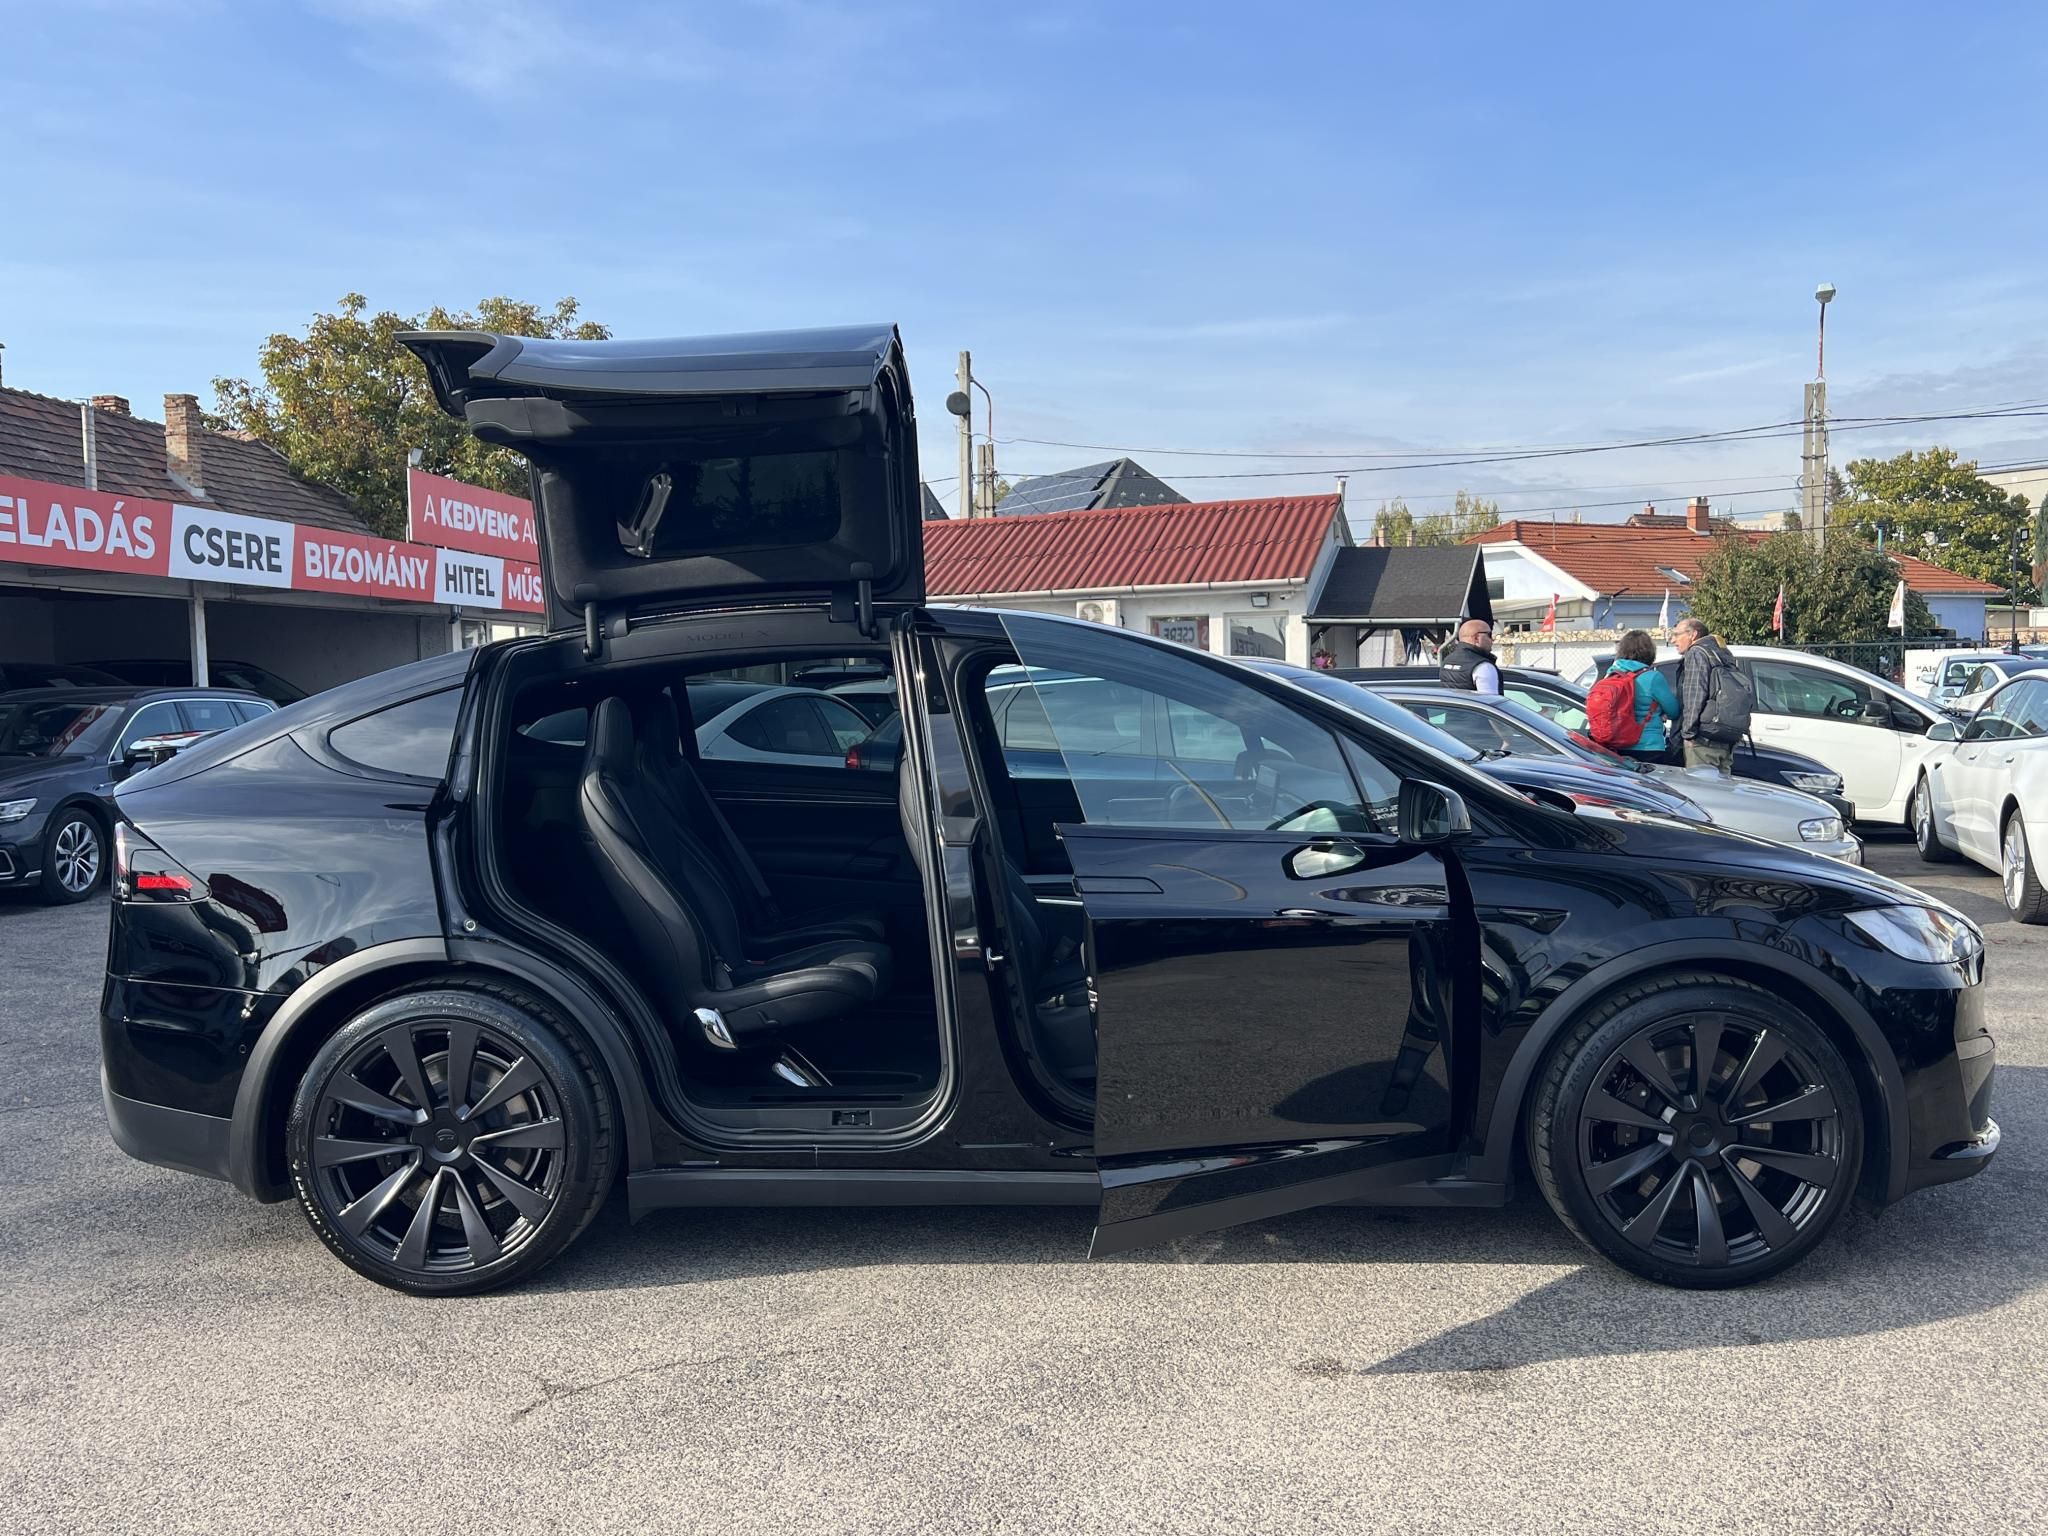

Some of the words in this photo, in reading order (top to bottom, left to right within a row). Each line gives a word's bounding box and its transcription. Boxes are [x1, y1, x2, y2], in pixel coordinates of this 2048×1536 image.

[423, 494, 437, 525] A
[440, 497, 519, 542] KEDVENC
[183, 524, 282, 573] CSERE
[304, 541, 429, 590] BIZOMÁNY
[445, 562, 495, 598] HITEL
[507, 567, 544, 604] MŰS
